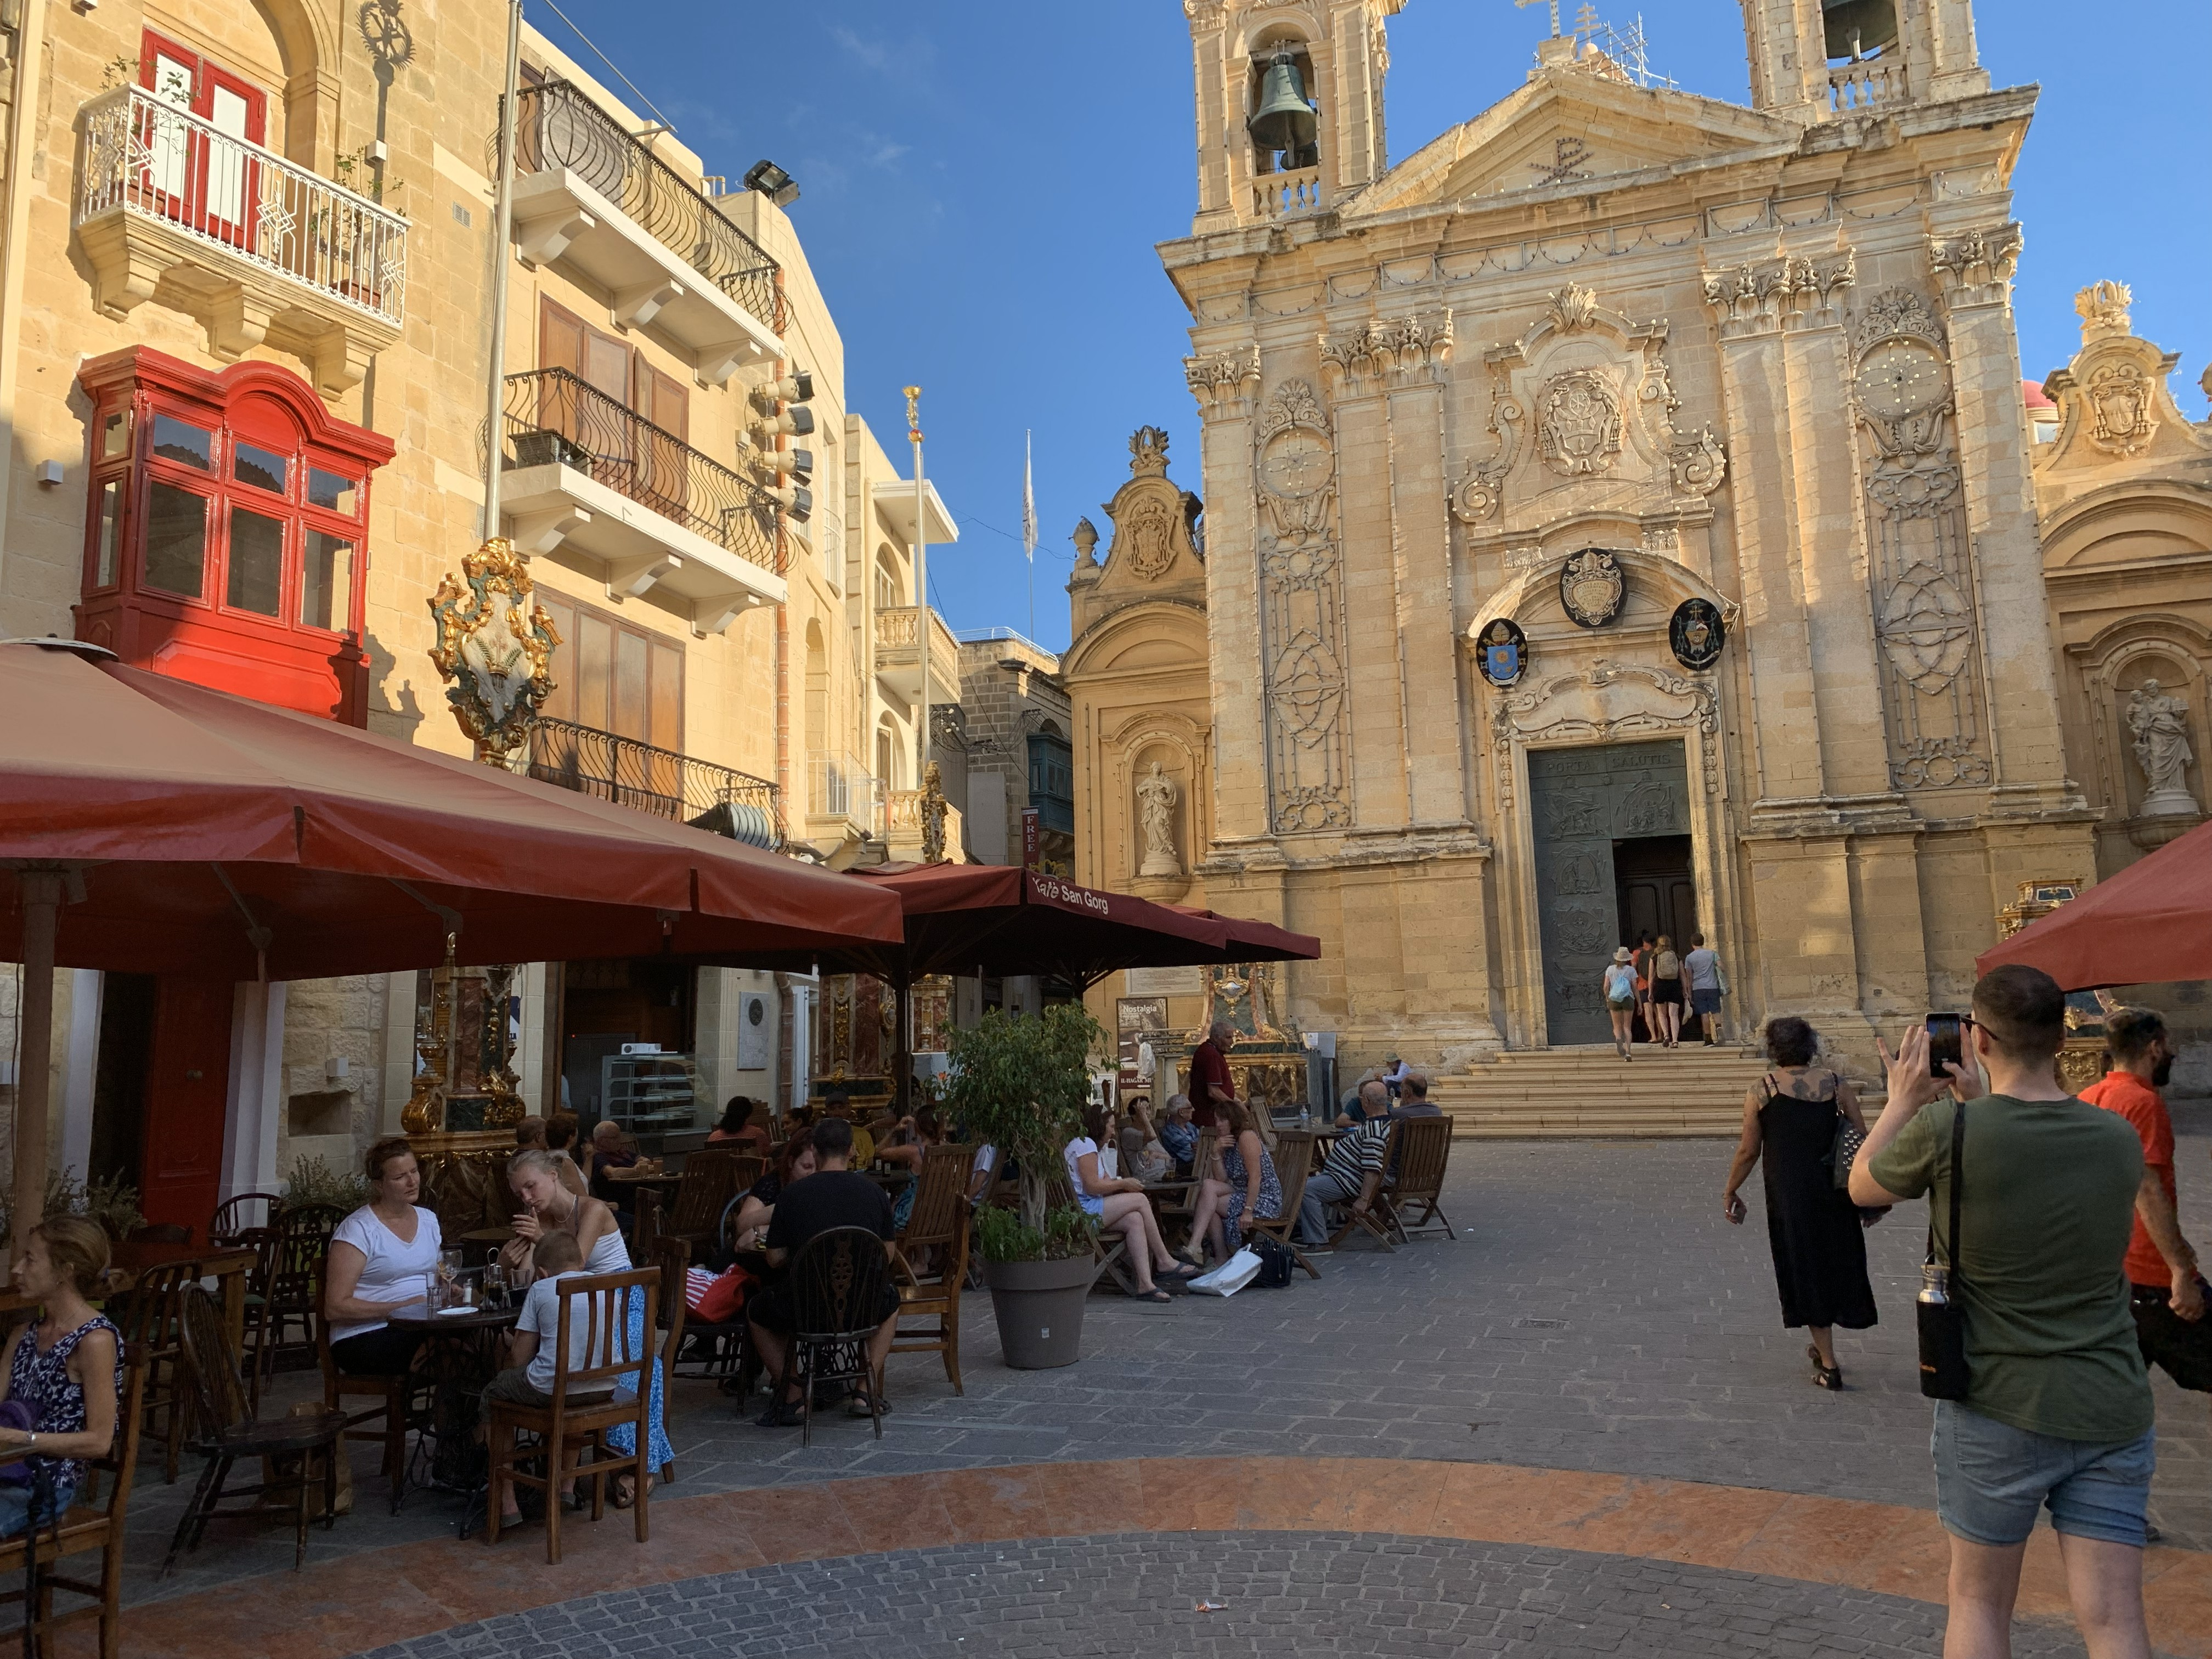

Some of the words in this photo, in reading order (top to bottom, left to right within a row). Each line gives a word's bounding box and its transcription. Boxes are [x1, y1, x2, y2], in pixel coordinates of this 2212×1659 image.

[1546, 760, 1591, 773] PORTA
[1612, 754, 1671, 768] SALUTIS
[1026, 815, 1035, 852] FREE
[1061, 885, 1083, 905] San
[1123, 1005, 1157, 1014] Nostalgia
